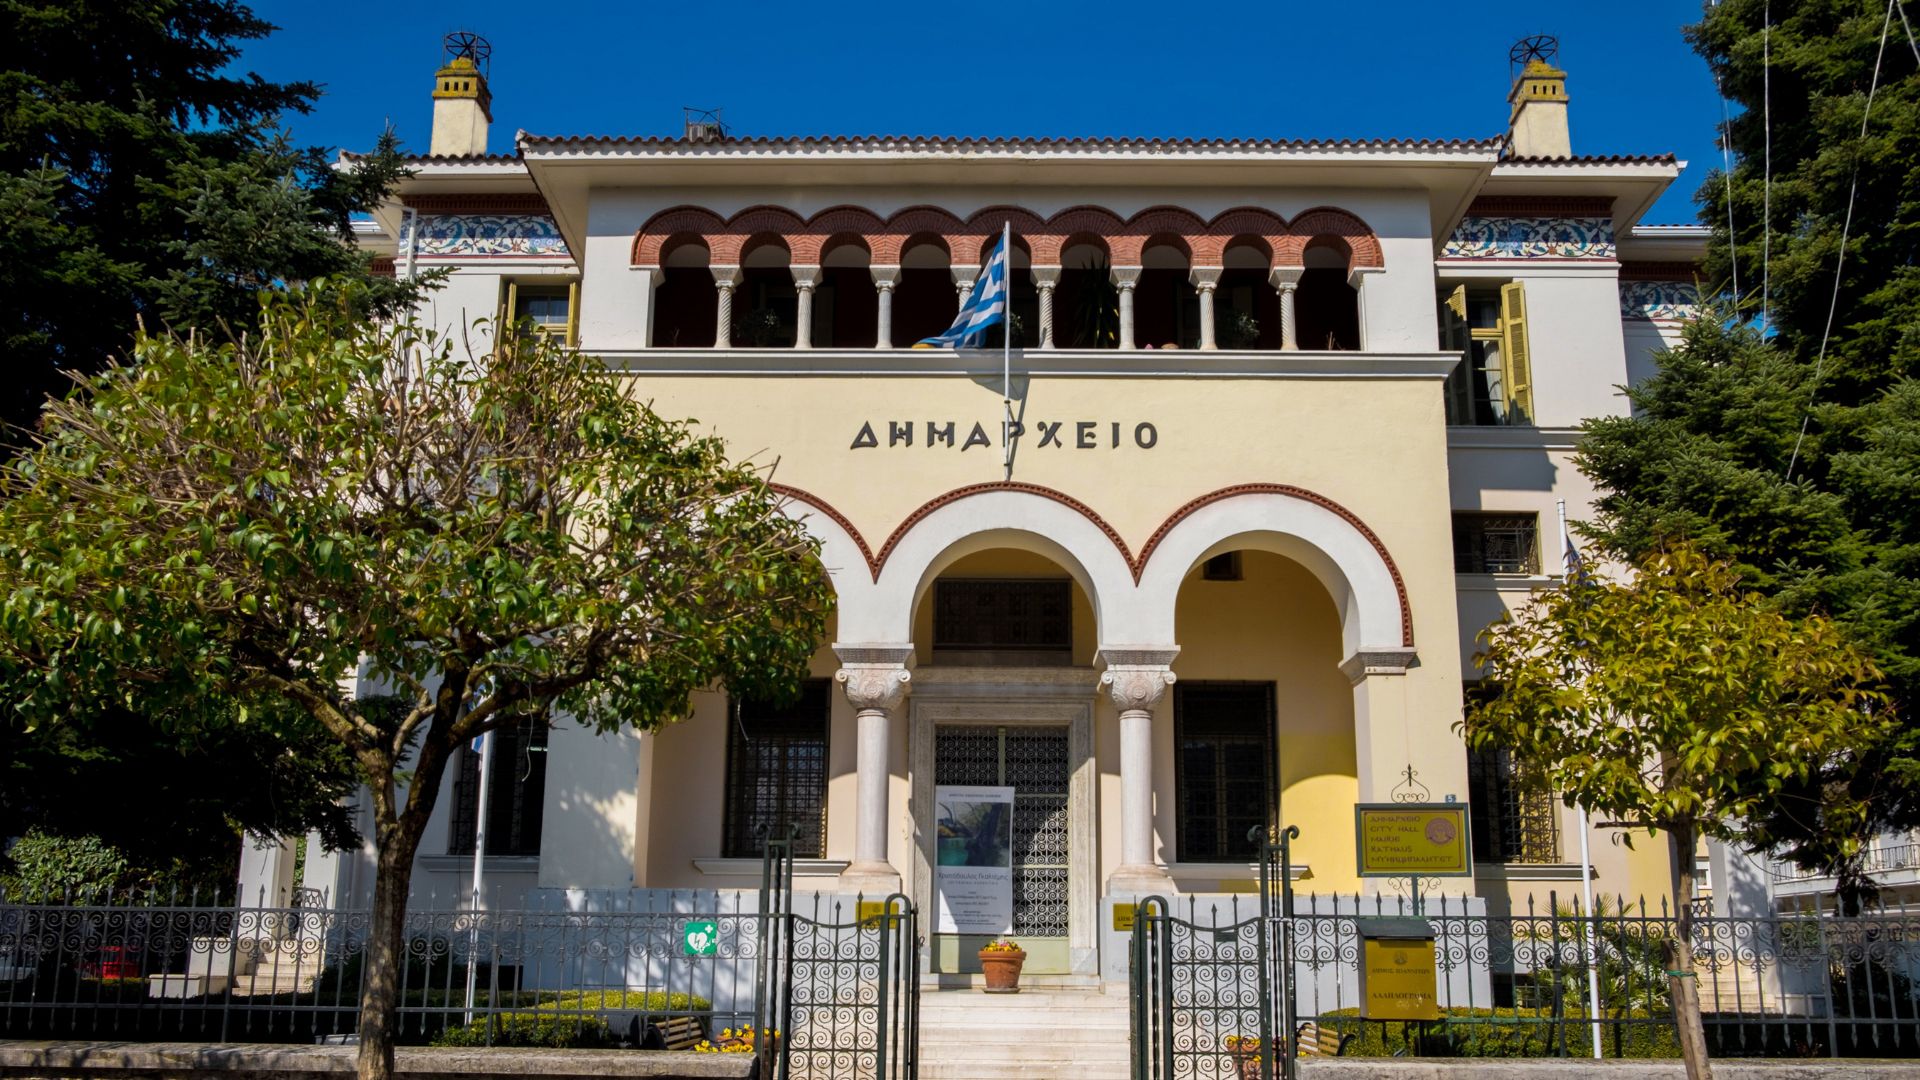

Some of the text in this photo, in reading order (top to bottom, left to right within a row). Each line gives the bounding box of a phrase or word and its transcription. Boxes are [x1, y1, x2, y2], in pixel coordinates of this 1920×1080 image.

[850, 420, 1158, 451] ΔΗΜΑΡΧΕΙΟ
[1370, 825, 1420, 833] CITY HALL
